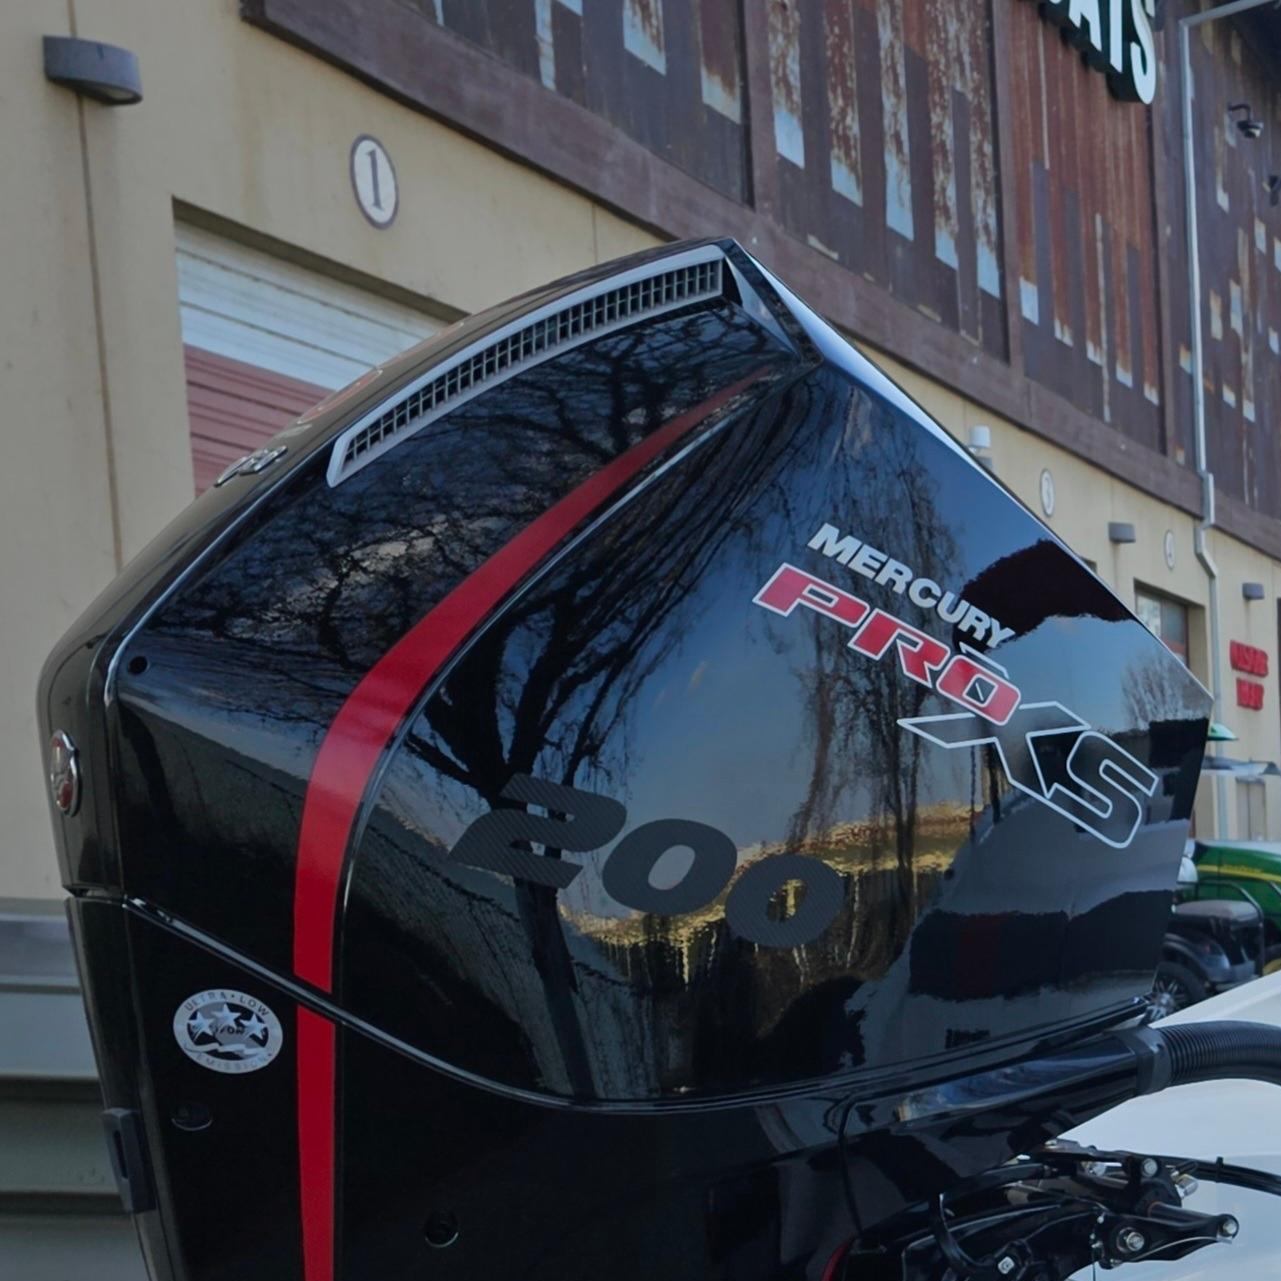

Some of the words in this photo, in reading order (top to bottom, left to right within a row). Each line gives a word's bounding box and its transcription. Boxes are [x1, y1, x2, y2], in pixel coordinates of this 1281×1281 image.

[365, 148, 384, 212] 1
[752, 562, 1021, 726] PRO
[807, 523, 1016, 648] MERCURY
[897, 641, 1159, 849] XS
[448, 773, 846, 948] 200
[184, 991, 227, 1012] ULTRA
[239, 996, 269, 1016] LOW
